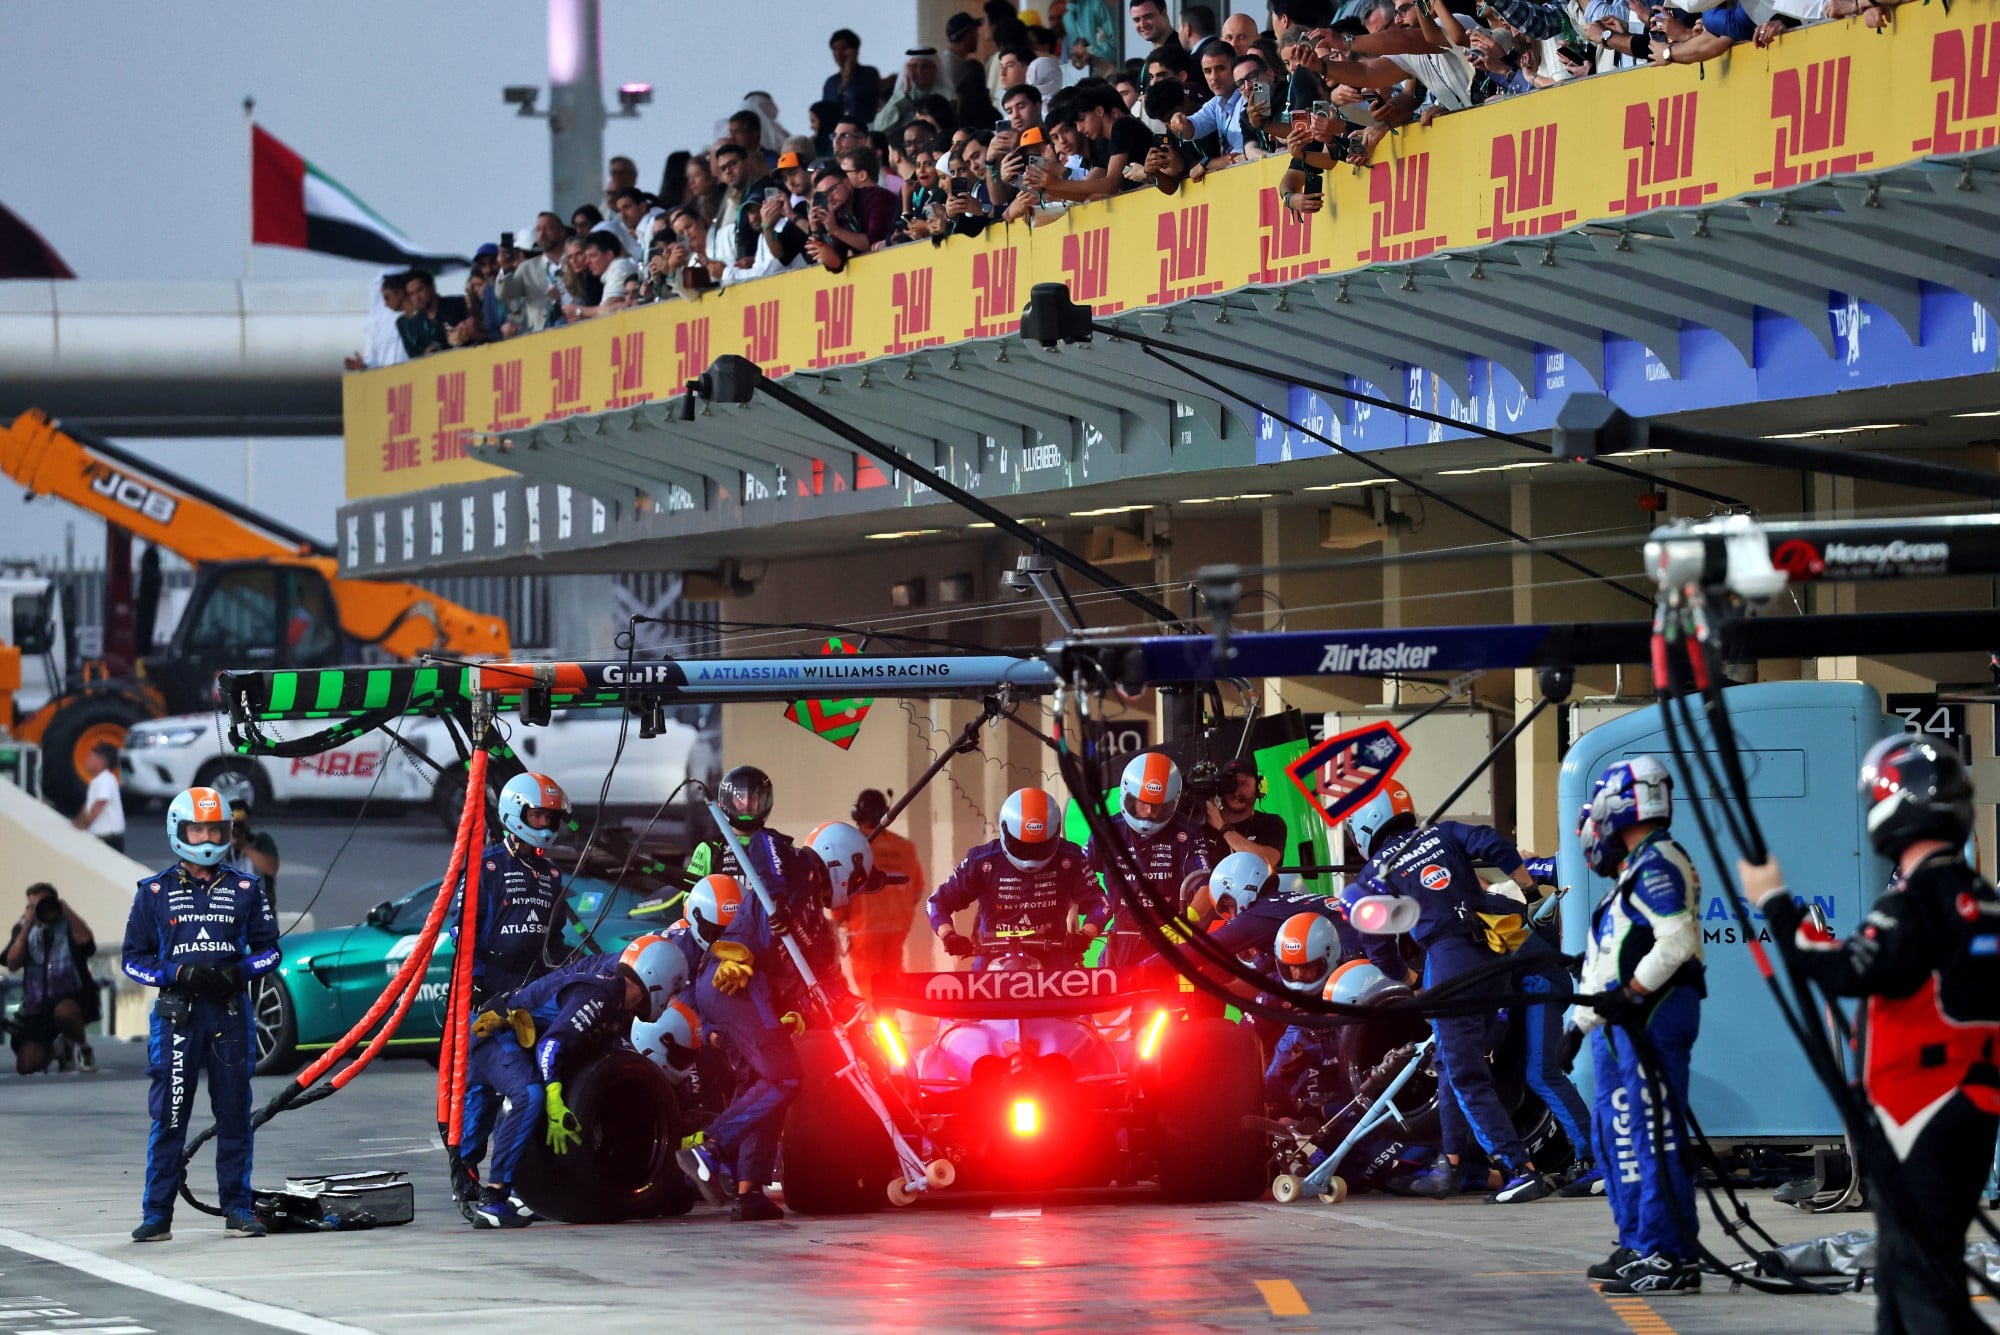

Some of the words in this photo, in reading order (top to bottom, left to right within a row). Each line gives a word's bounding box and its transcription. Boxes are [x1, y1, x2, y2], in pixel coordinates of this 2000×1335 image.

[92, 473, 177, 523] JCB
[1824, 540, 1949, 573] MoneyGram
[1318, 642, 1438, 672] Airtasker
[602, 665, 668, 683] Gulf
[713, 667, 799, 679] ATLASSIAN
[803, 665, 884, 678] WILLIAMS
[887, 663, 950, 677] RACING
[1895, 706, 1955, 739] 34
[290, 751, 380, 778] FIRE
[1025, 822, 1044, 831] Gulf
[1423, 867, 1448, 887] Gulf
[178, 913, 235, 924] MYPROTEIN
[173, 941, 236, 956] ATLASSIAN
[968, 968, 1117, 1000] kraken
